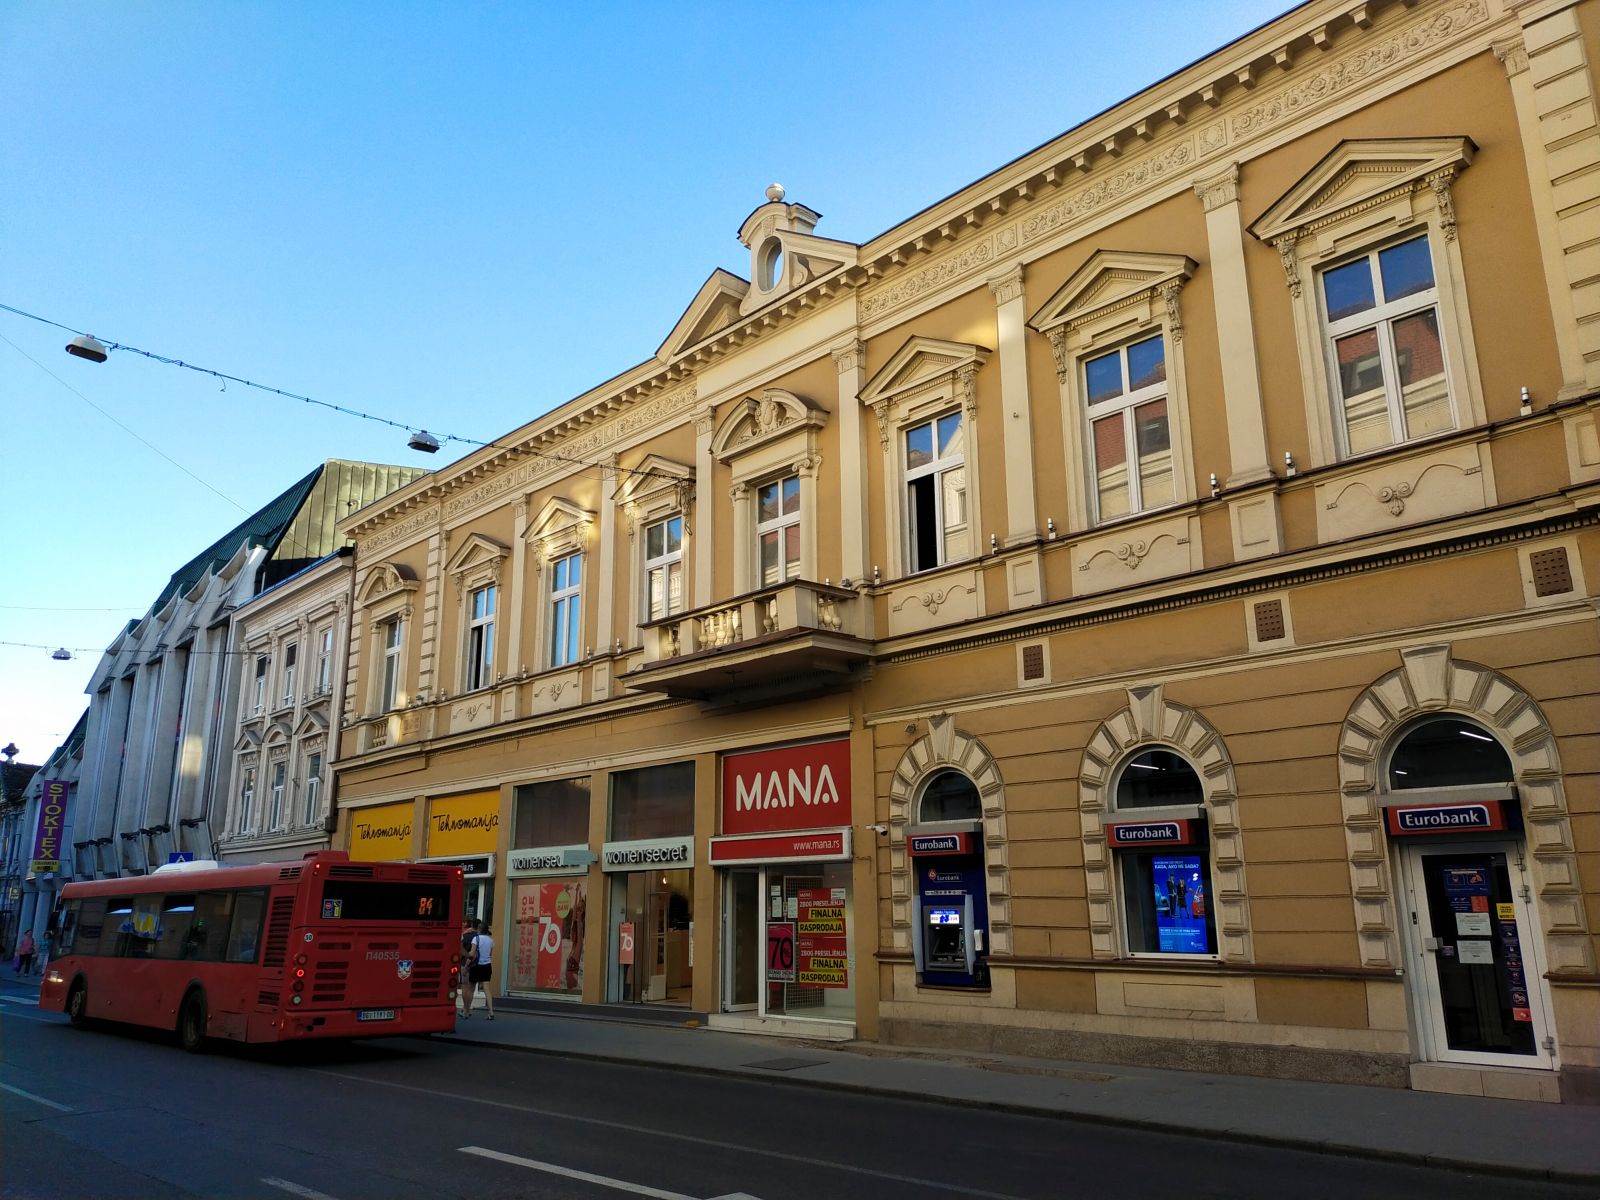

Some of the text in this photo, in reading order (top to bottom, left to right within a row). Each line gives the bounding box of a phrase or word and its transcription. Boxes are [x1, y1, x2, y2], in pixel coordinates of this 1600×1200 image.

[736, 764, 839, 811] MANA
[41, 783, 63, 859] STOKTEX
[433, 813, 499, 832] Tehnomanija
[1405, 810, 1479, 826] Eurobank
[357, 822, 412, 840] Tehnomanija
[1120, 826, 1173, 839] Eurobank
[793, 839, 840, 850] www.mana.rs
[915, 839, 954, 850] Eurobank
[606, 846, 685, 863] women'secret
[811, 909, 843, 918] FINALNA
[800, 923, 843, 932] RASPRODAJA
[812, 959, 845, 968] FINALNA
[801, 973, 844, 982] RASPRODAJA
